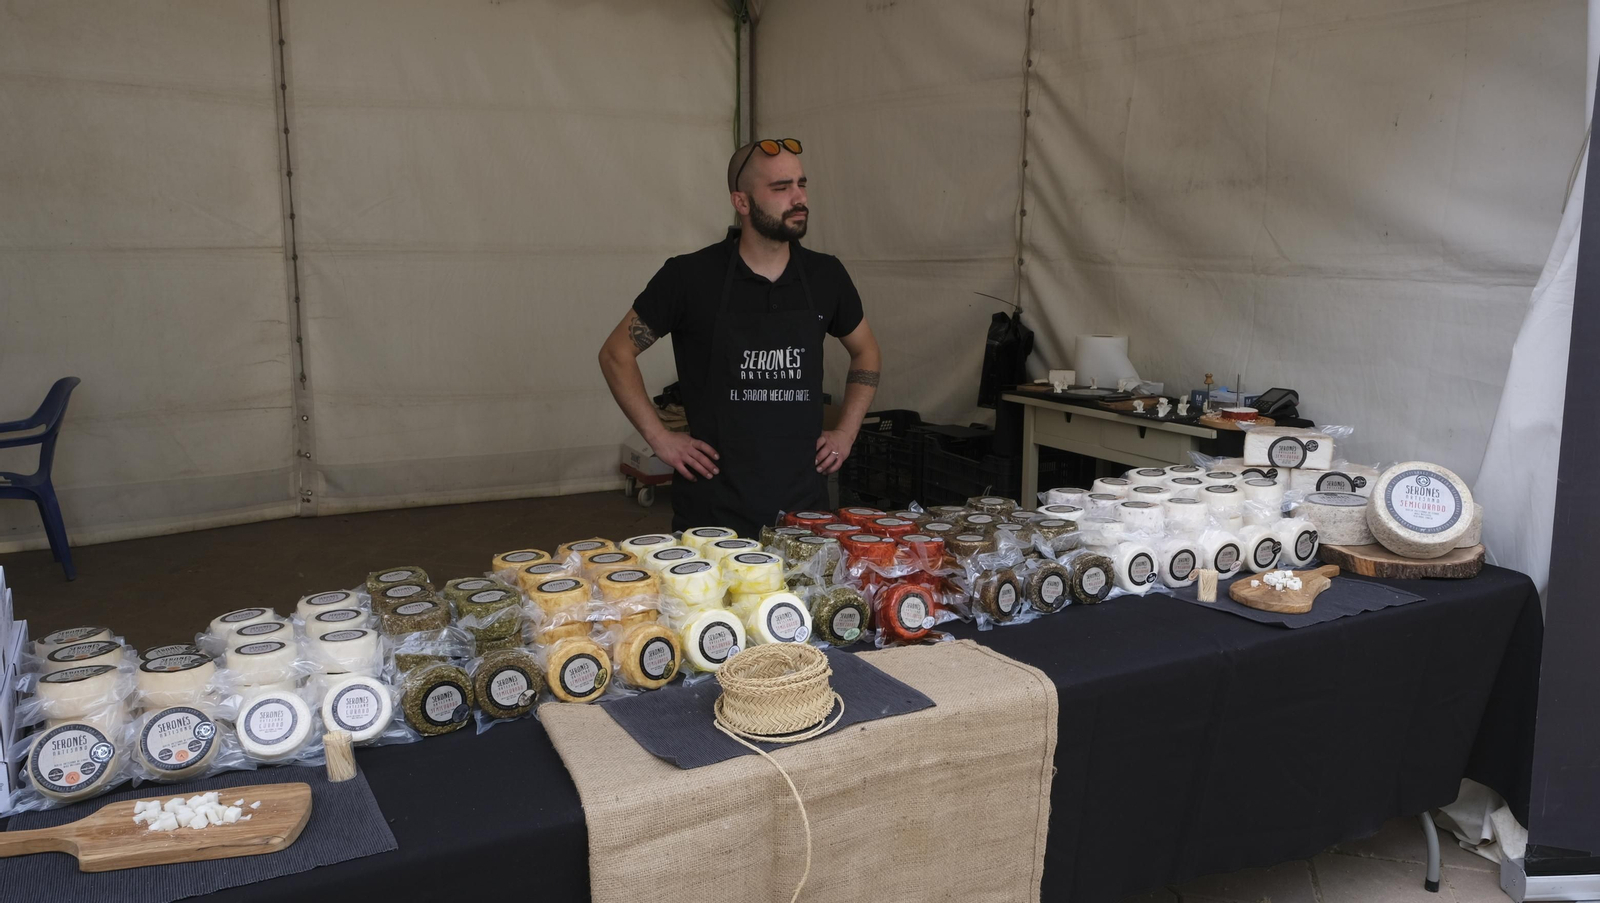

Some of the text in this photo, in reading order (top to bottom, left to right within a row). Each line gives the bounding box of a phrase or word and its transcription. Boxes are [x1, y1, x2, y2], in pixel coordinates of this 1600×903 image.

[740, 346, 801, 371] SERONÉS
[740, 369, 802, 380] ARTESANO
[730, 389, 740, 401] EL
[742, 389, 768, 402] SABOR
[769, 389, 795, 402] HECHO
[1405, 484, 1440, 498] SERONÉS
[1400, 499, 1446, 513] SEMICURADO
[1405, 494, 1440, 504] ARTESANO
[157, 715, 191, 734] SERONÉS
[52, 734, 88, 751] SERONÉS
